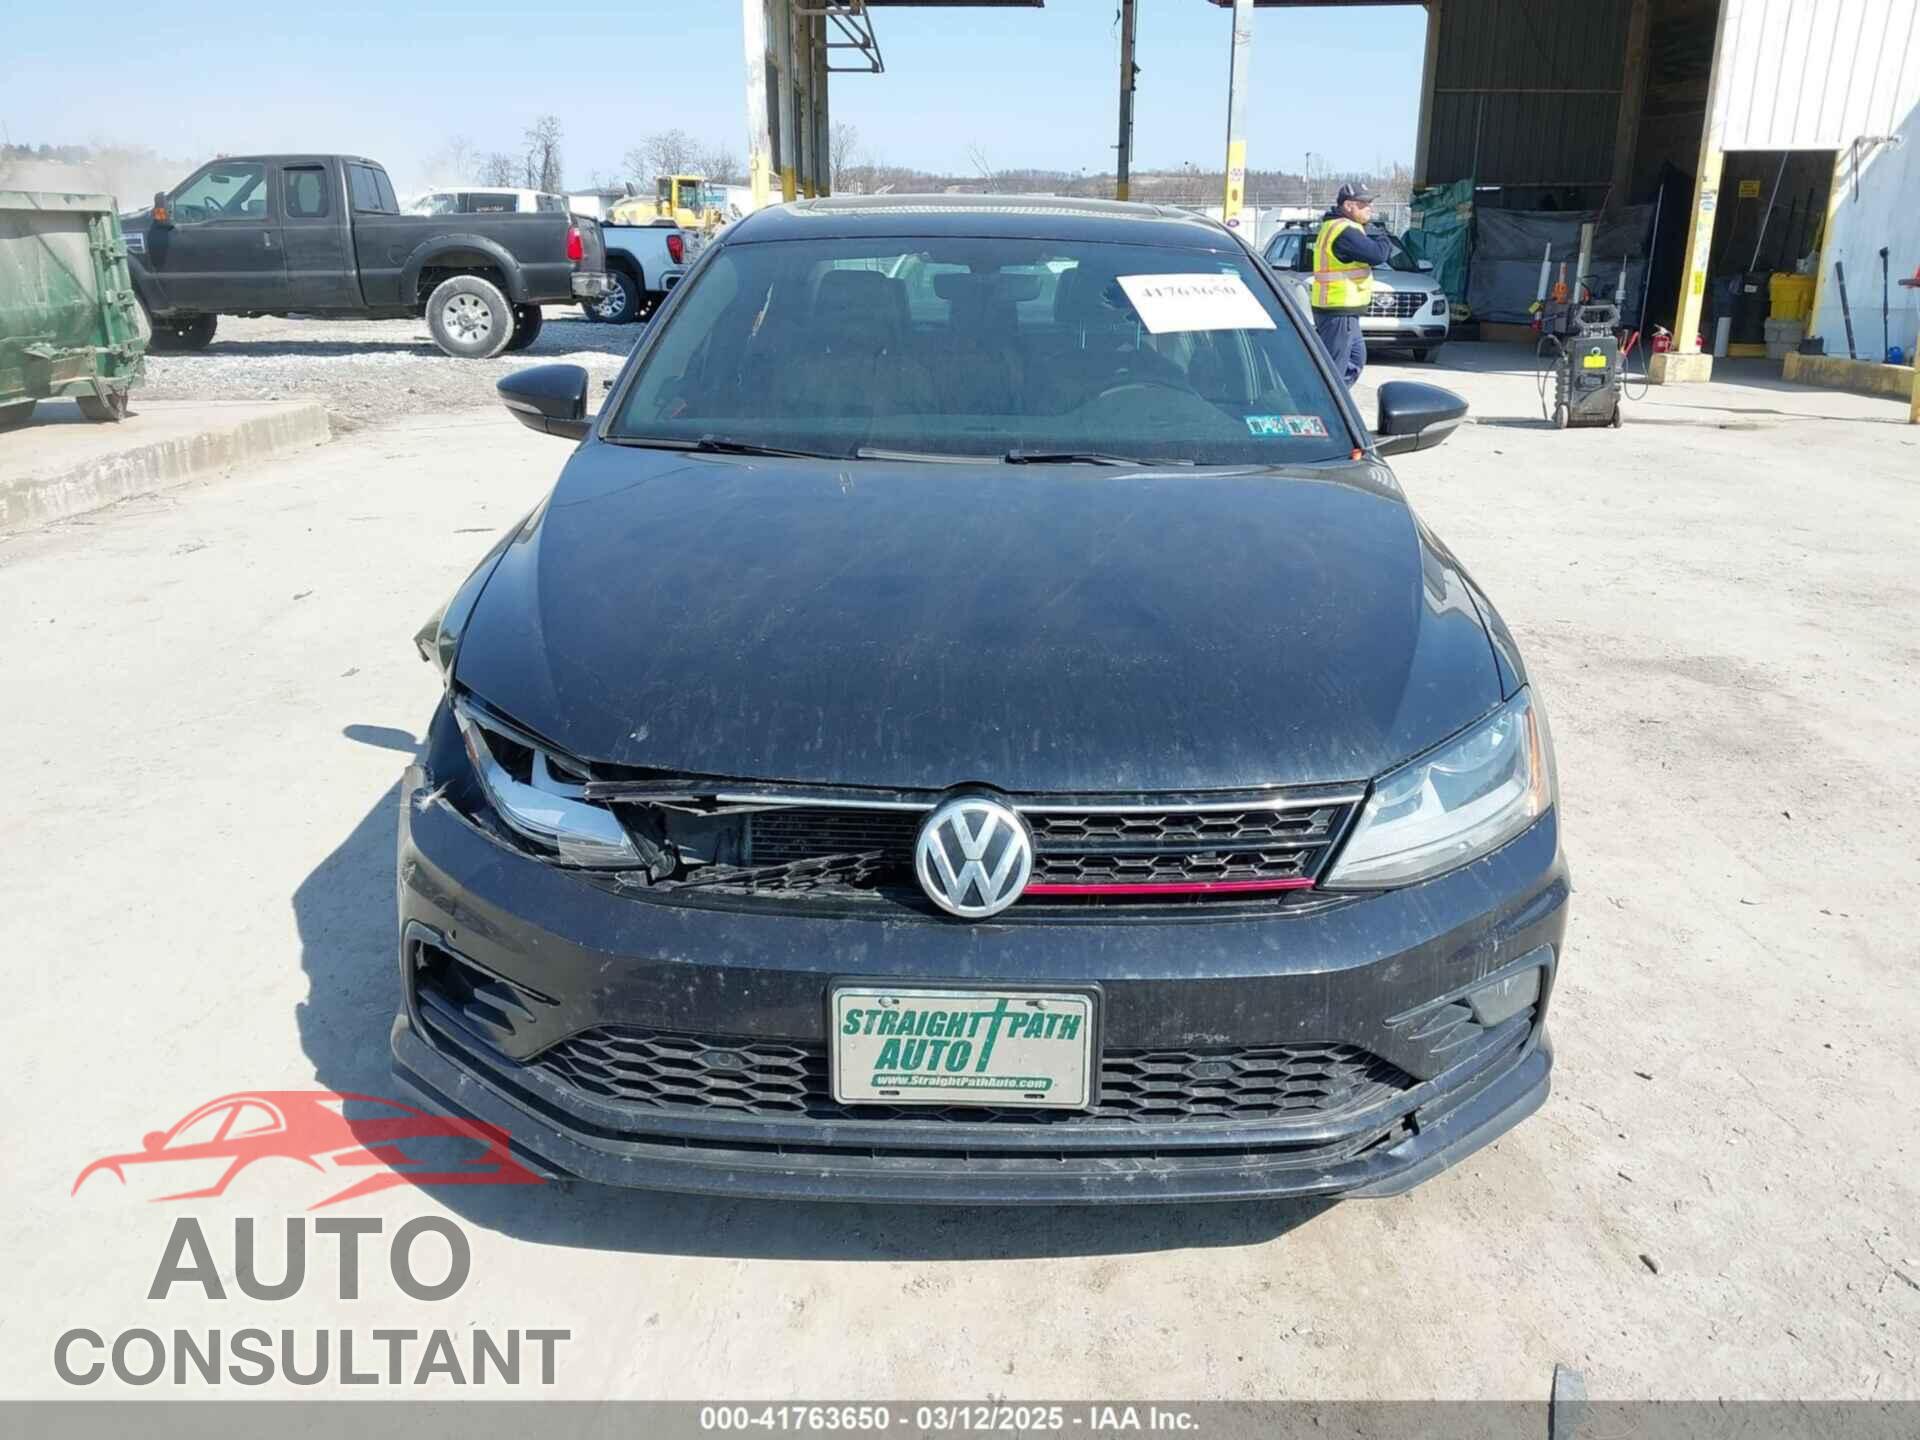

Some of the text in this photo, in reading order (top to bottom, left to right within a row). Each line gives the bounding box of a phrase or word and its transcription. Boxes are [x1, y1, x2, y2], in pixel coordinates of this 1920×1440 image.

[842, 1008, 1082, 1041] STRAIGHT PATH
[874, 1038, 973, 1073] AUTO
[876, 1074, 1048, 1090] www.StraightPathAuto.com
